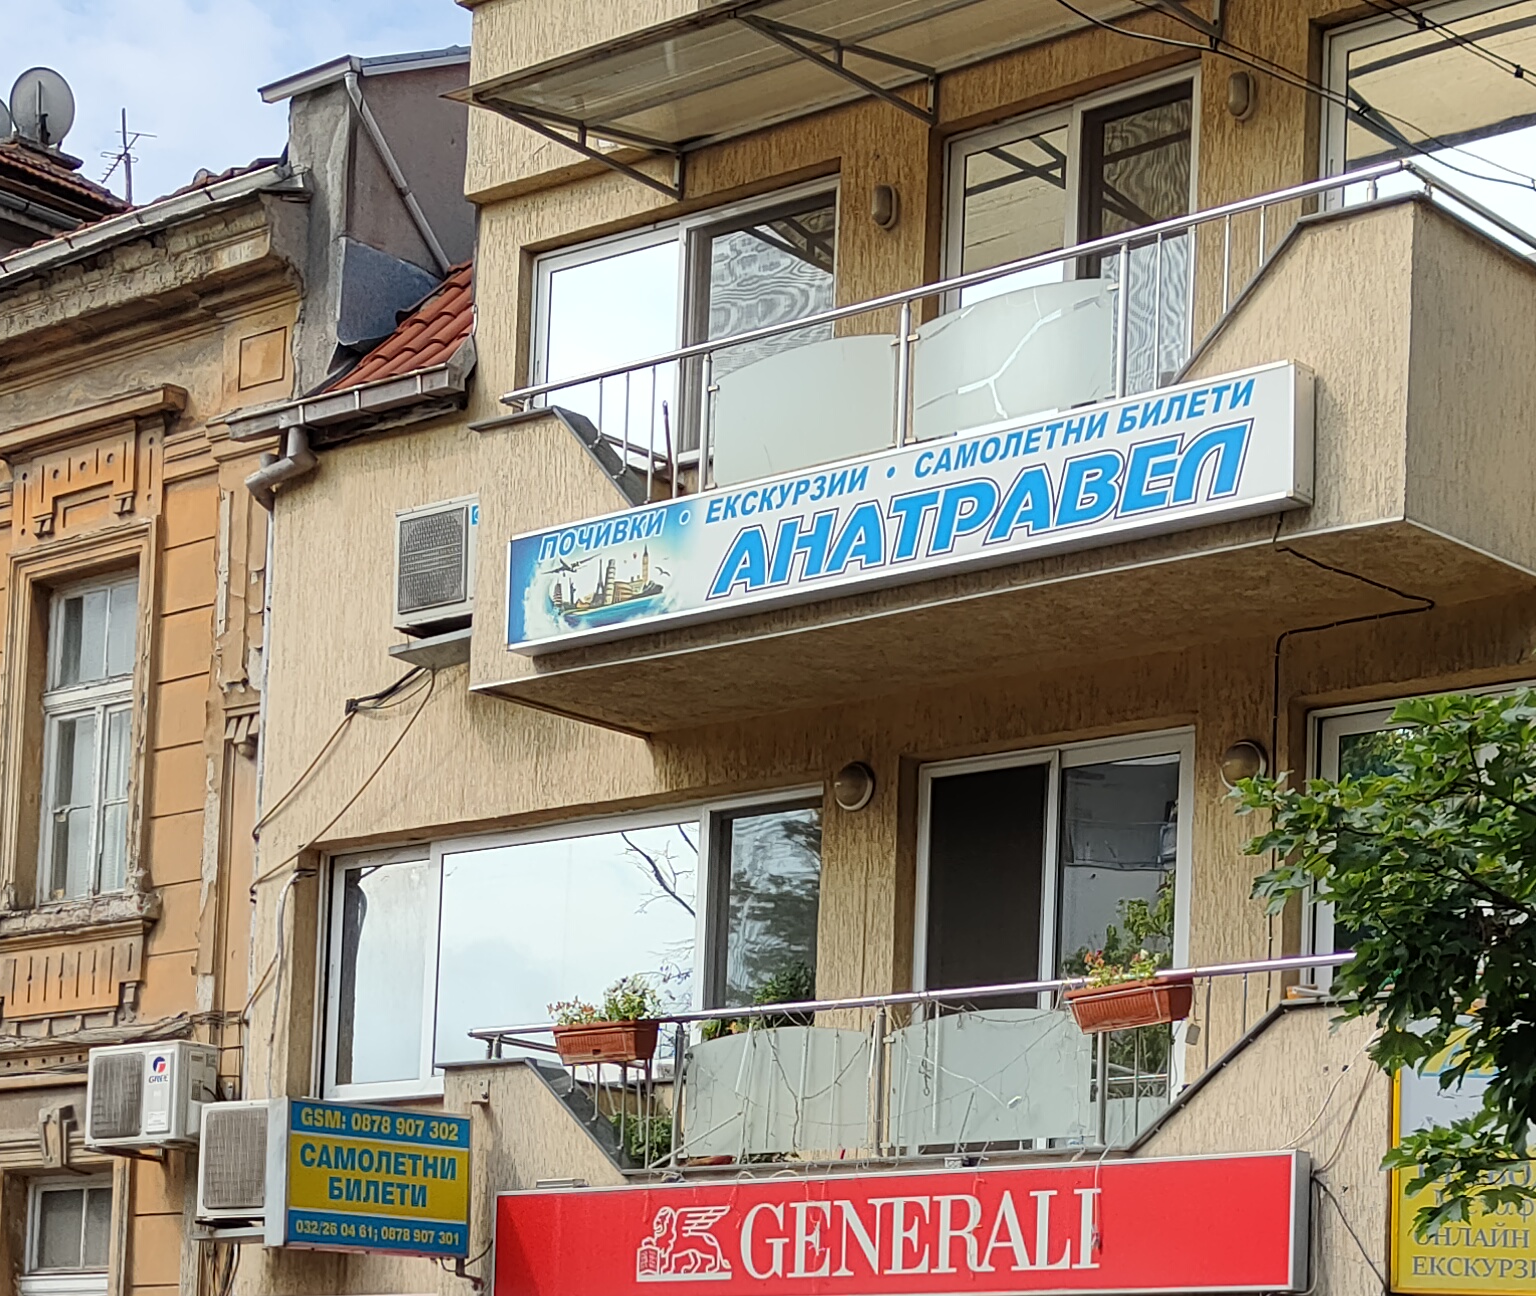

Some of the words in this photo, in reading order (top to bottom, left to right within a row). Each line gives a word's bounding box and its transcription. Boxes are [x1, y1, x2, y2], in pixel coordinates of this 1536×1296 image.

[538, 508, 667, 561] ПОЧИВКИ
[705, 464, 871, 526] ЕКСКУРЗИИ
[912, 408, 1110, 478] САМОЛЕТНИ
[1115, 377, 1257, 435] БИЛЕТИ
[705, 416, 1254, 601] АНАТРАВЕЛ
[300, 1106, 347, 1131] GSM:
[351, 1112, 392, 1135] 0878
[395, 1117, 425, 1138] 907
[429, 1121, 460, 1142] 302
[300, 1142, 458, 1182] САМОЛЕТНИ
[328, 1176, 428, 1208] БИЛЕТИ
[295, 1219, 338, 1236] 032/26
[340, 1221, 357, 1238] 04
[380, 1225, 411, 1242] 0878
[413, 1229, 436, 1244] 907
[438, 1230, 460, 1246] 301
[739, 1185, 1104, 1280] GENERALI
